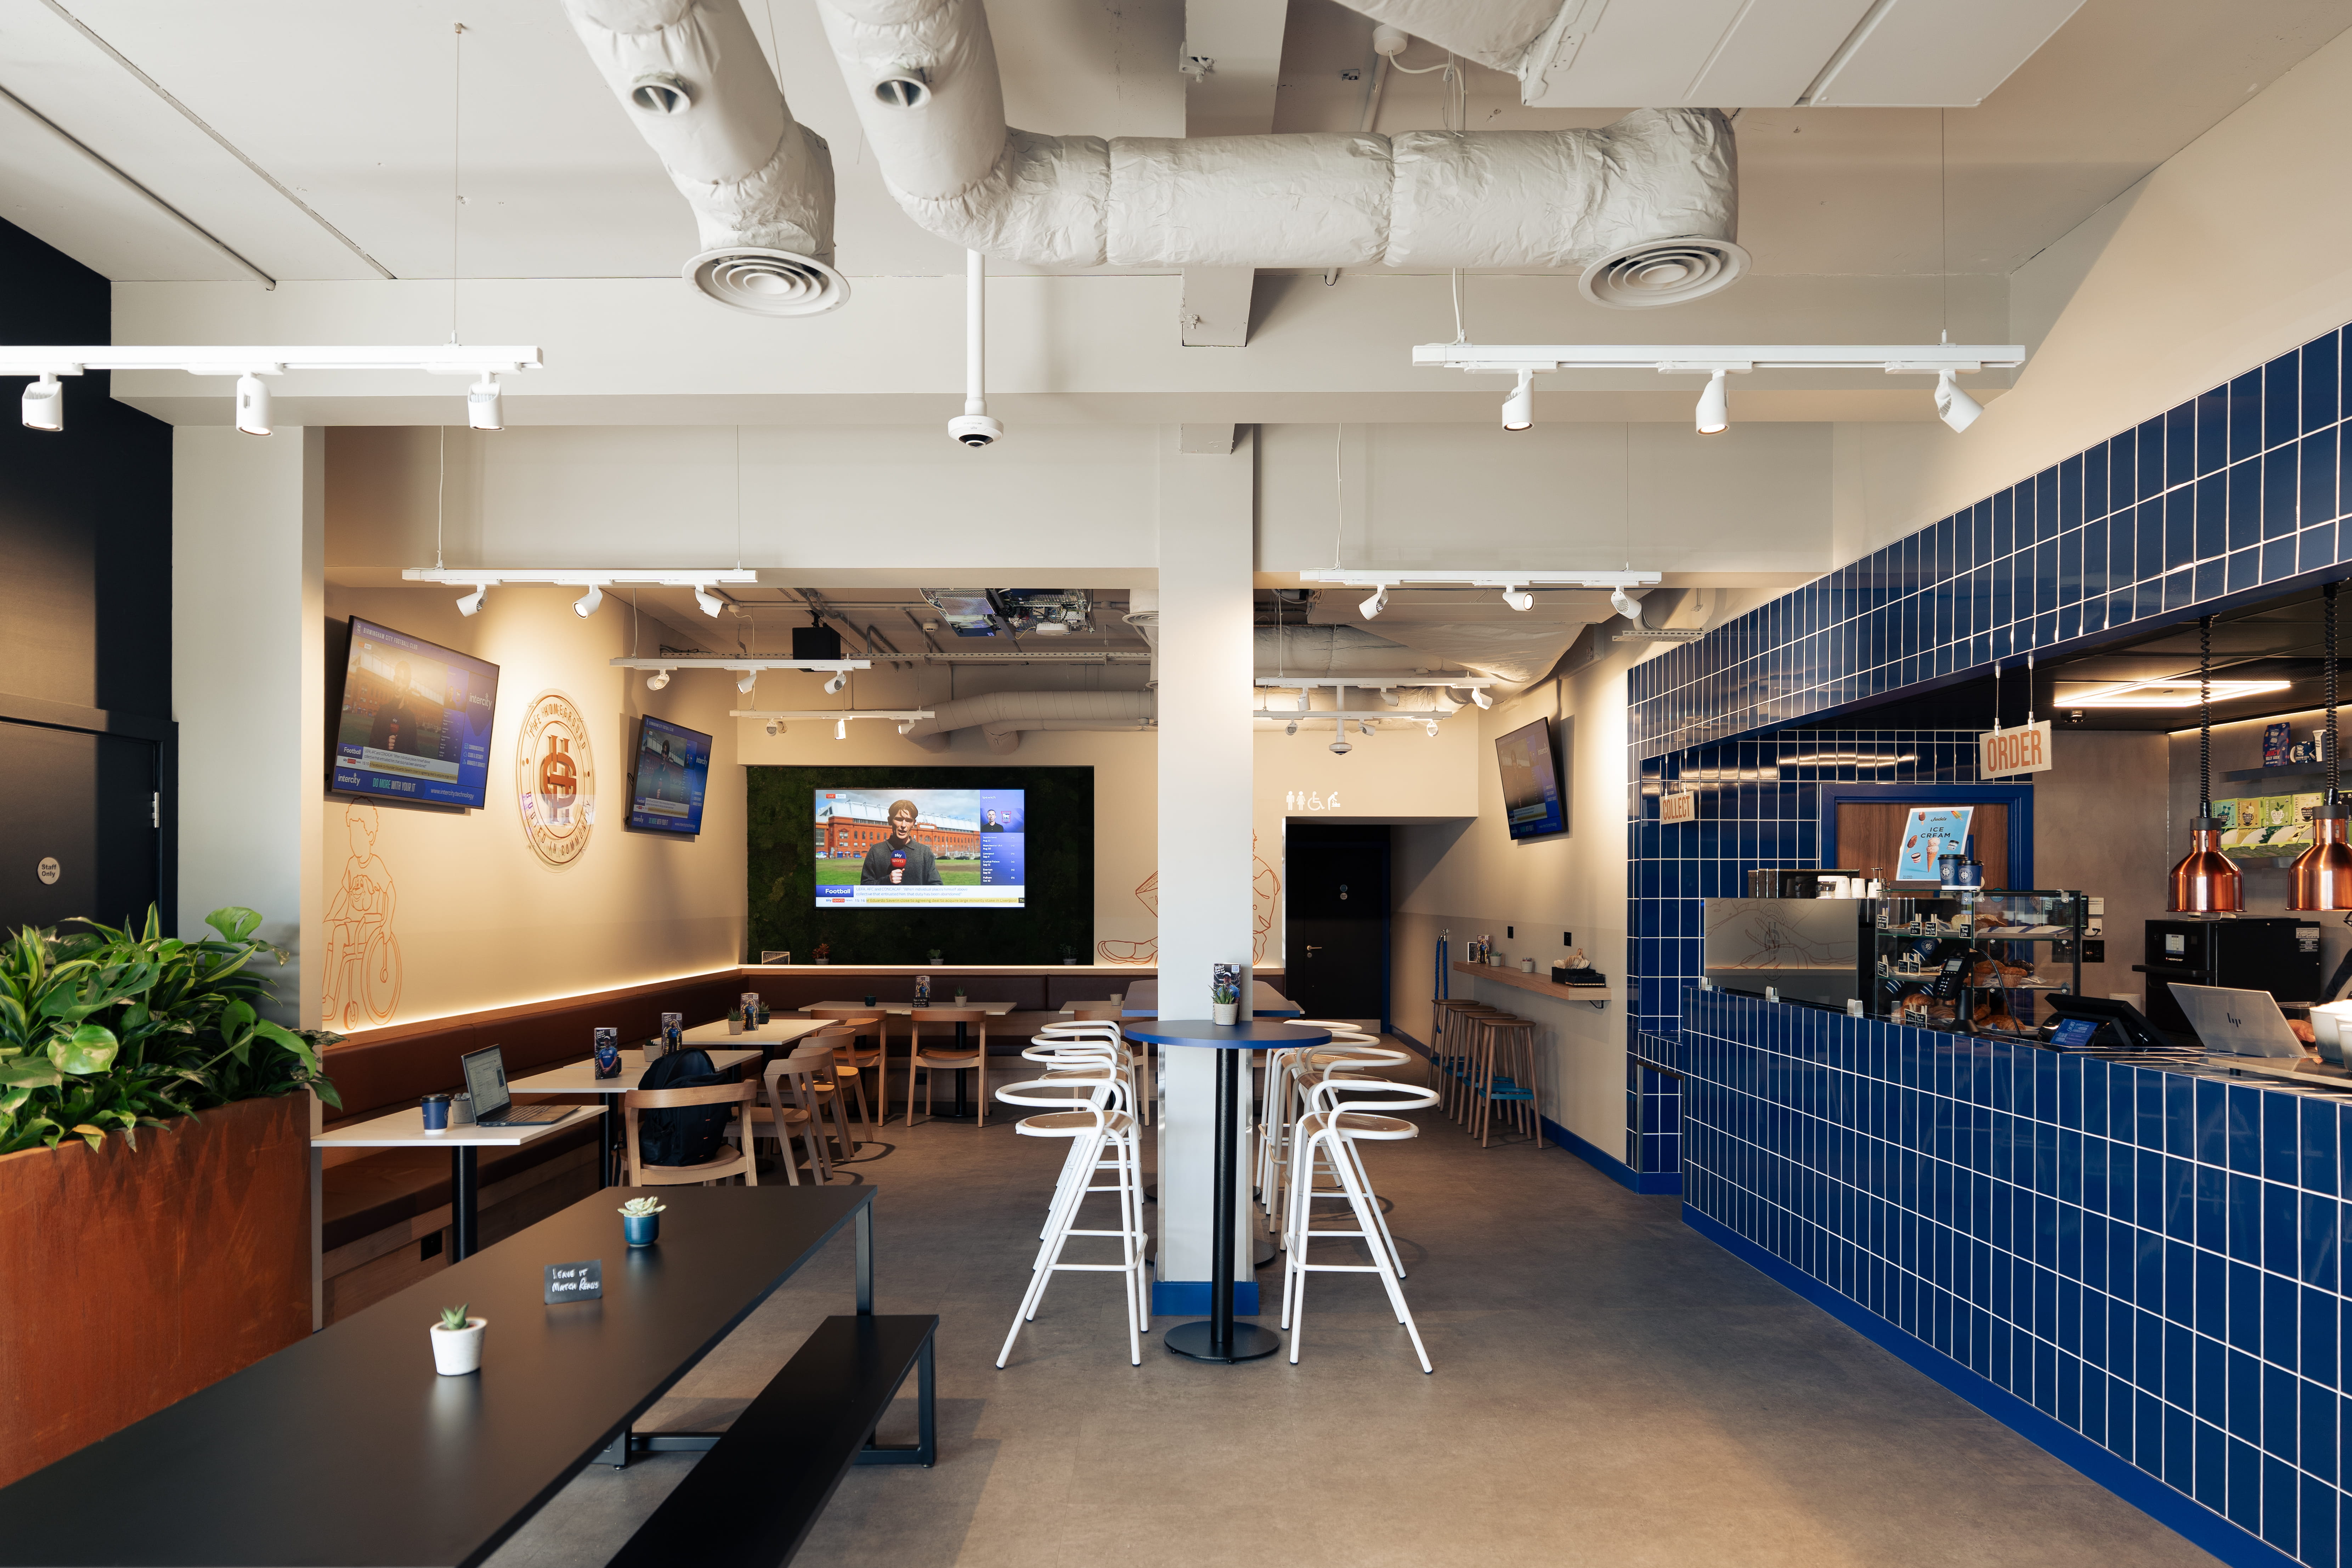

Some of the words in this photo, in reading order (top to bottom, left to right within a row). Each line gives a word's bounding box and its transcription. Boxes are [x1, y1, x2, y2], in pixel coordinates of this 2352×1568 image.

[363, 628, 384, 639] BIRMINGHAM
[394, 638, 409, 647] FOOTBALL
[469, 693, 492, 710] intercity
[544, 704, 586, 750] HOMEGROUND
[1538, 746, 1549, 758] intercity
[1987, 730, 2042, 772] ORDER
[696, 755, 708, 767] intercity
[338, 773, 361, 786] intercity
[372, 778, 379, 787] DO
[379, 779, 391, 789] MORE
[391, 780, 401, 790] WITH
[402, 782, 411, 792] YOUR
[411, 783, 416, 792] IT
[431, 788, 474, 800] www.intercity.technology
[1663, 796, 1690, 820] COLLECT
[526, 792, 546, 844] ROOTED
[561, 800, 591, 855] COMMUNITY
[553, 1268, 576, 1279] LEAVE
[579, 1268, 589, 1277] IT
[552, 1281, 578, 1292] MATCH
[579, 1277, 599, 1291] READY
